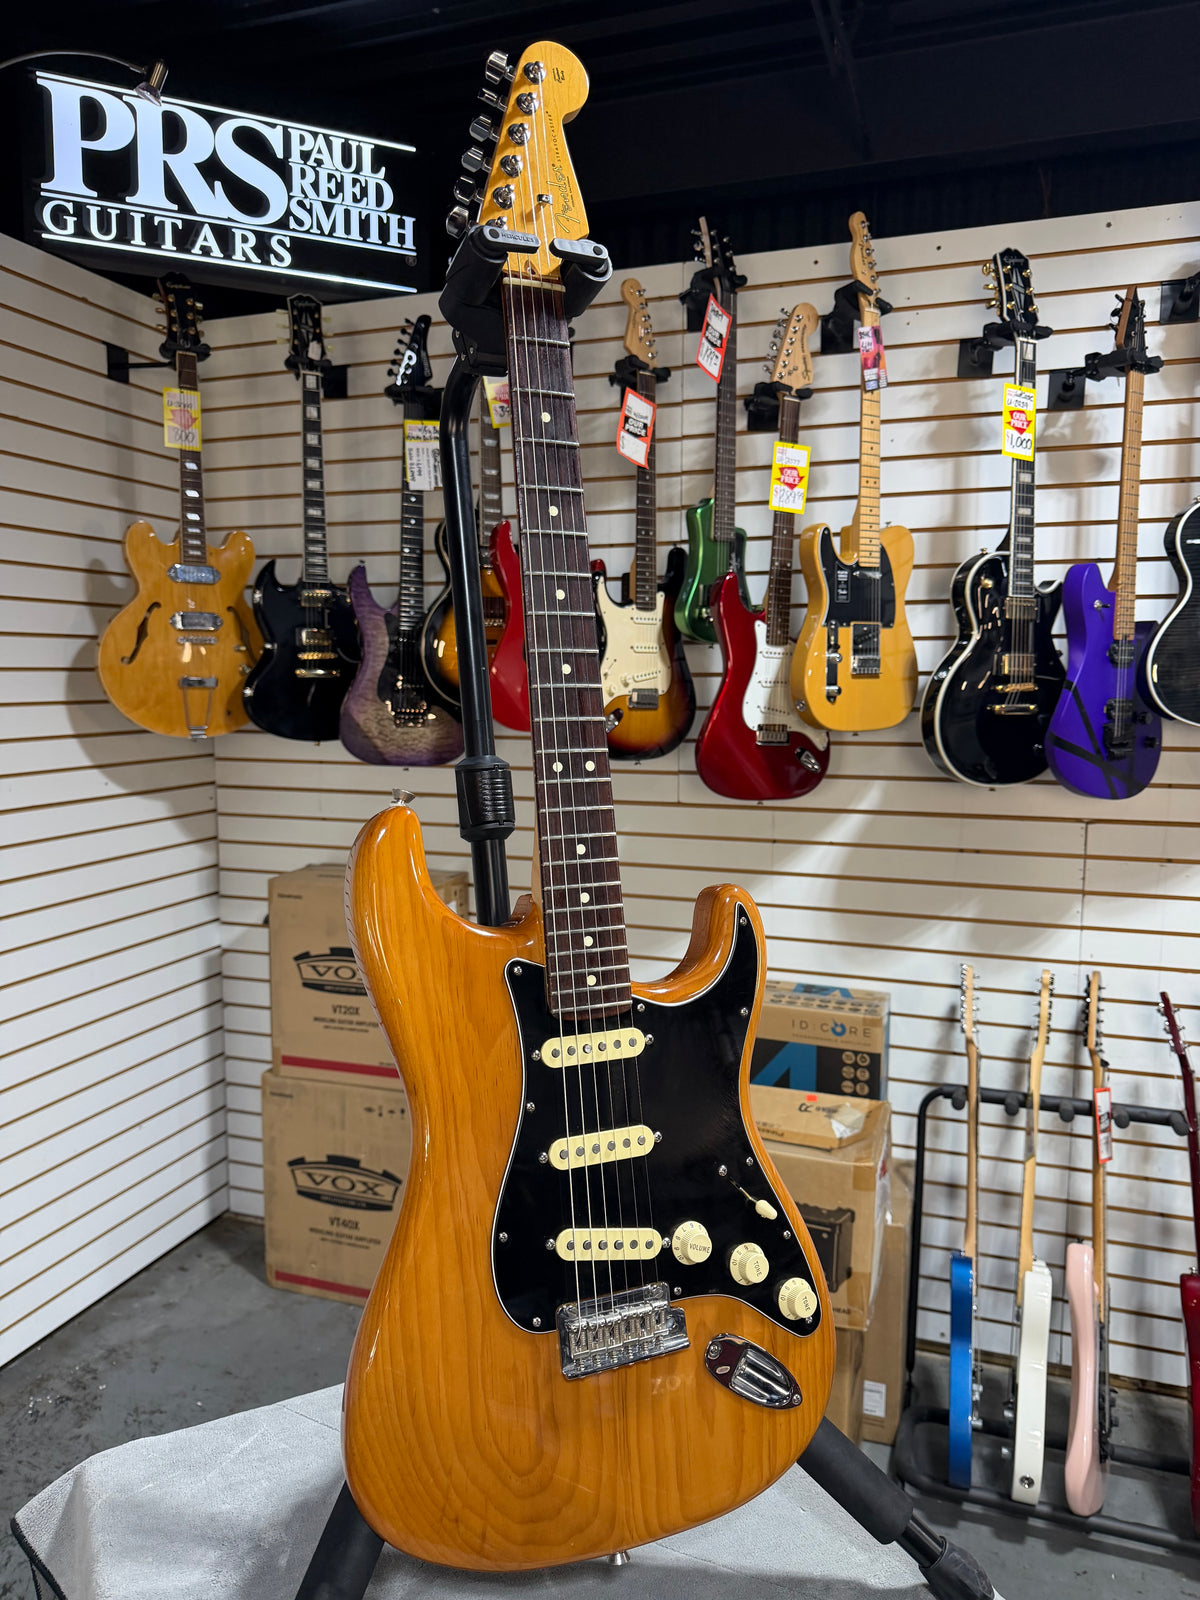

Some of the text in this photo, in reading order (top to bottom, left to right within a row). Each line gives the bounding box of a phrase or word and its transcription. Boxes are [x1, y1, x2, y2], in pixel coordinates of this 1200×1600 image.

[37, 77, 289, 226] PRS
[288, 127, 386, 180] PAUL
[288, 162, 394, 212] REED
[289, 197, 417, 250] SMITH
[41, 200, 292, 268] GUITARS
[628, 418, 644, 429] OUR
[1010, 419, 1029, 430] PRICE
[1012, 411, 1027, 421] OUR
[624, 424, 647, 437] PRICE
[306, 964, 363, 981] VO
[300, 1170, 386, 1198] VOX
[689, 1242, 711, 1254] VOLUME
[753, 1260, 763, 1277] TONE
[802, 1296, 812, 1312] TONE
